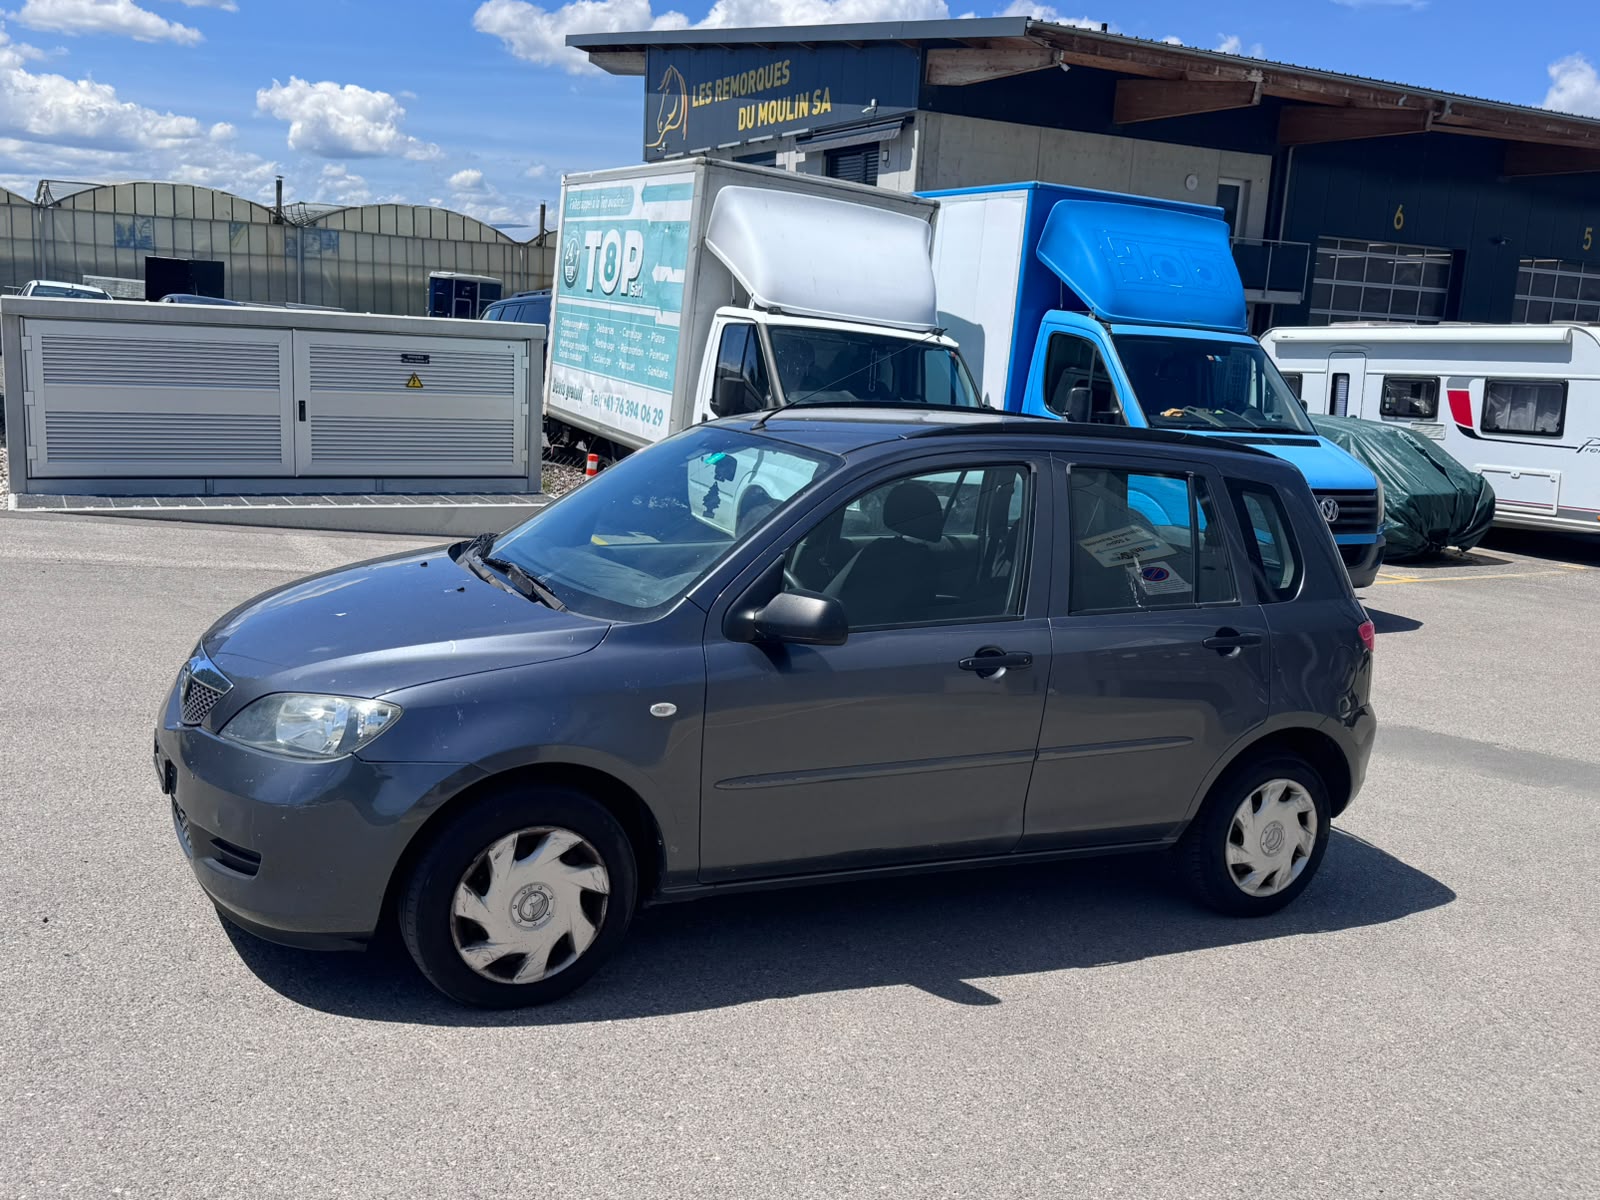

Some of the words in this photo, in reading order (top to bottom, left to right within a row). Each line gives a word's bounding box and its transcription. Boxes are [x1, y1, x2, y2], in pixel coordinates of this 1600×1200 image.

[692, 81, 713, 107] LES
[715, 60, 791, 102] REMORQUES
[738, 104, 756, 131] DU
[758, 91, 809, 127] MOULIN
[811, 86, 831, 115] SA
[1393, 204, 1405, 230] 6
[1582, 227, 1594, 250] 5
[615, 398, 625, 415] 76
[625, 399, 640, 419] 394
[641, 404, 652, 424] 06
[652, 408, 664, 427] 29
